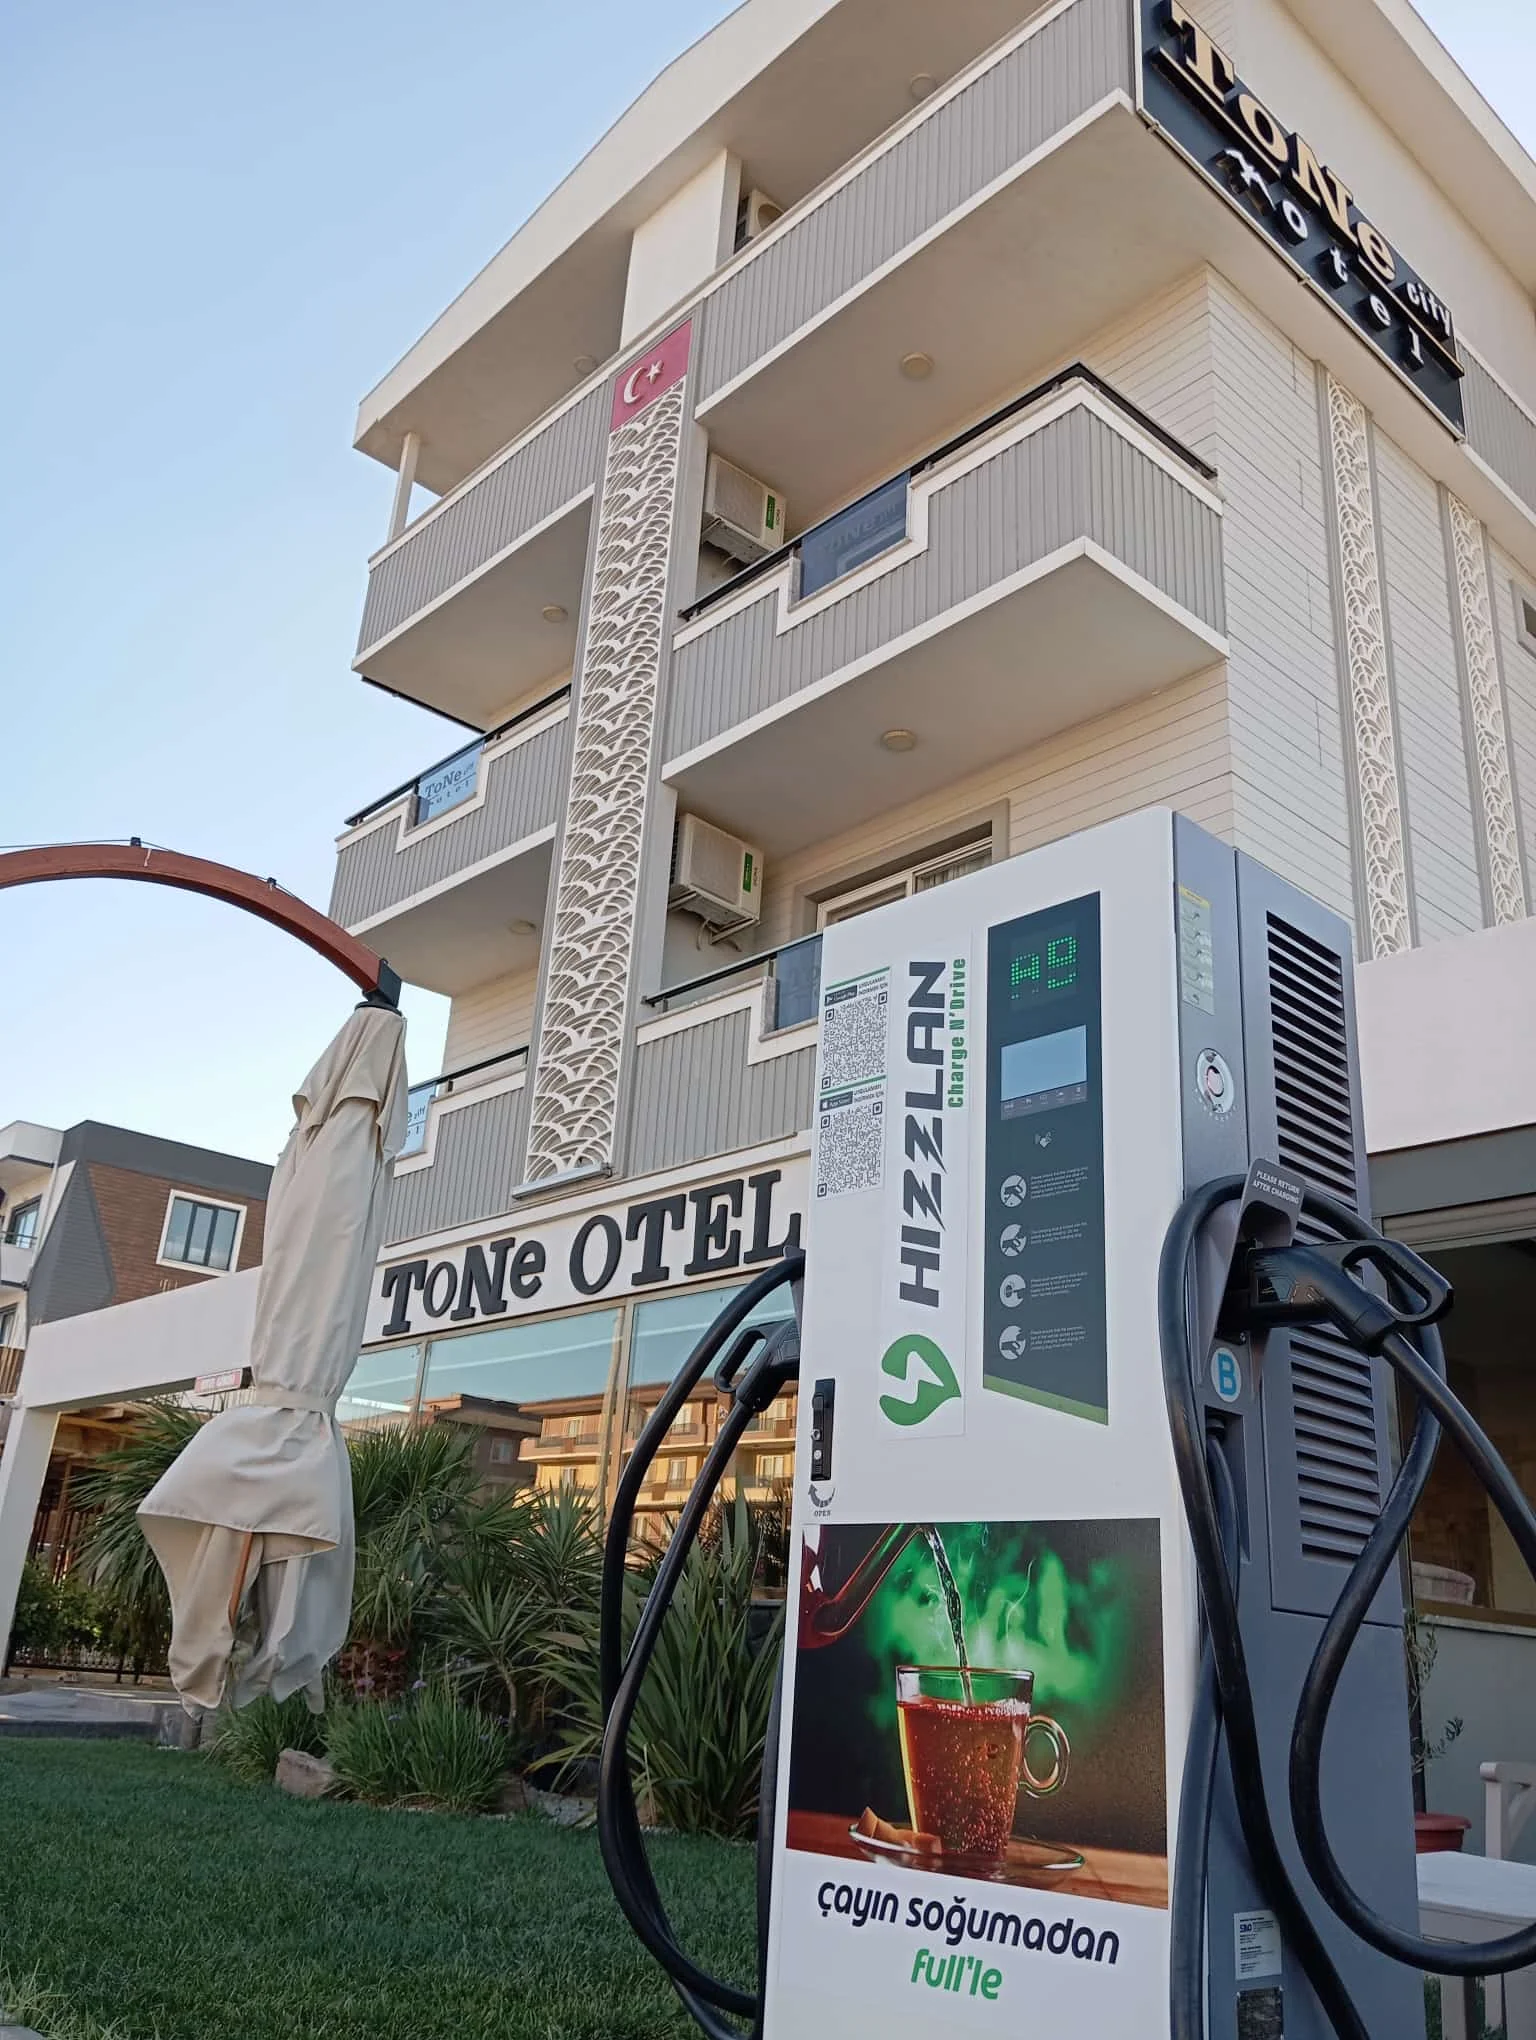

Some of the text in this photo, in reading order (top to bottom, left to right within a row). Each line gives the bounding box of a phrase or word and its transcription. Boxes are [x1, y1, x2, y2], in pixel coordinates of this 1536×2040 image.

[1406, 281, 1452, 335] city
[947, 958, 968, 1108] Charge N'Drive
[899, 960, 947, 1308] HIZZLAN
[1253, 1180, 1271, 1193] AFTER
[1256, 1170, 1278, 1185] PLEASE
[568, 1168, 802, 1296] OTEL
[1217, 1352, 1237, 1396] B
[817, 1881, 1120, 1964] çayın soğumadan
[911, 1948, 1002, 2000] full'le
